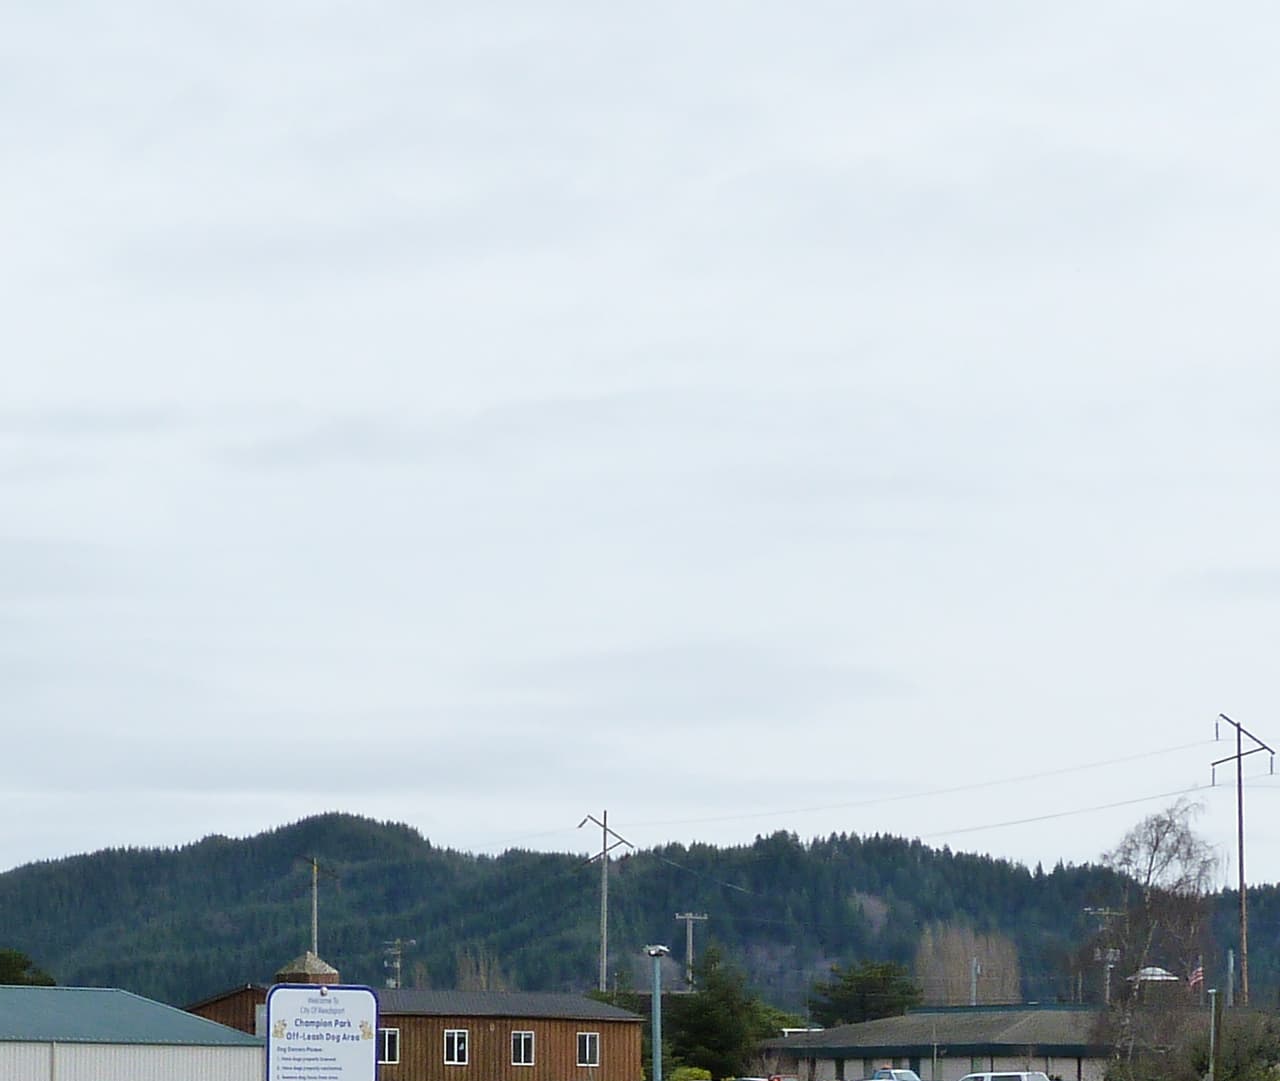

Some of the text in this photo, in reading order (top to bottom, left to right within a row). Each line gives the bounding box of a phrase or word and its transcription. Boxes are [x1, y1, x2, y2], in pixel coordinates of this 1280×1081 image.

[294, 1018, 352, 1029] Champion Park
[286, 1032, 361, 1043] Off-Leash Dog Area
